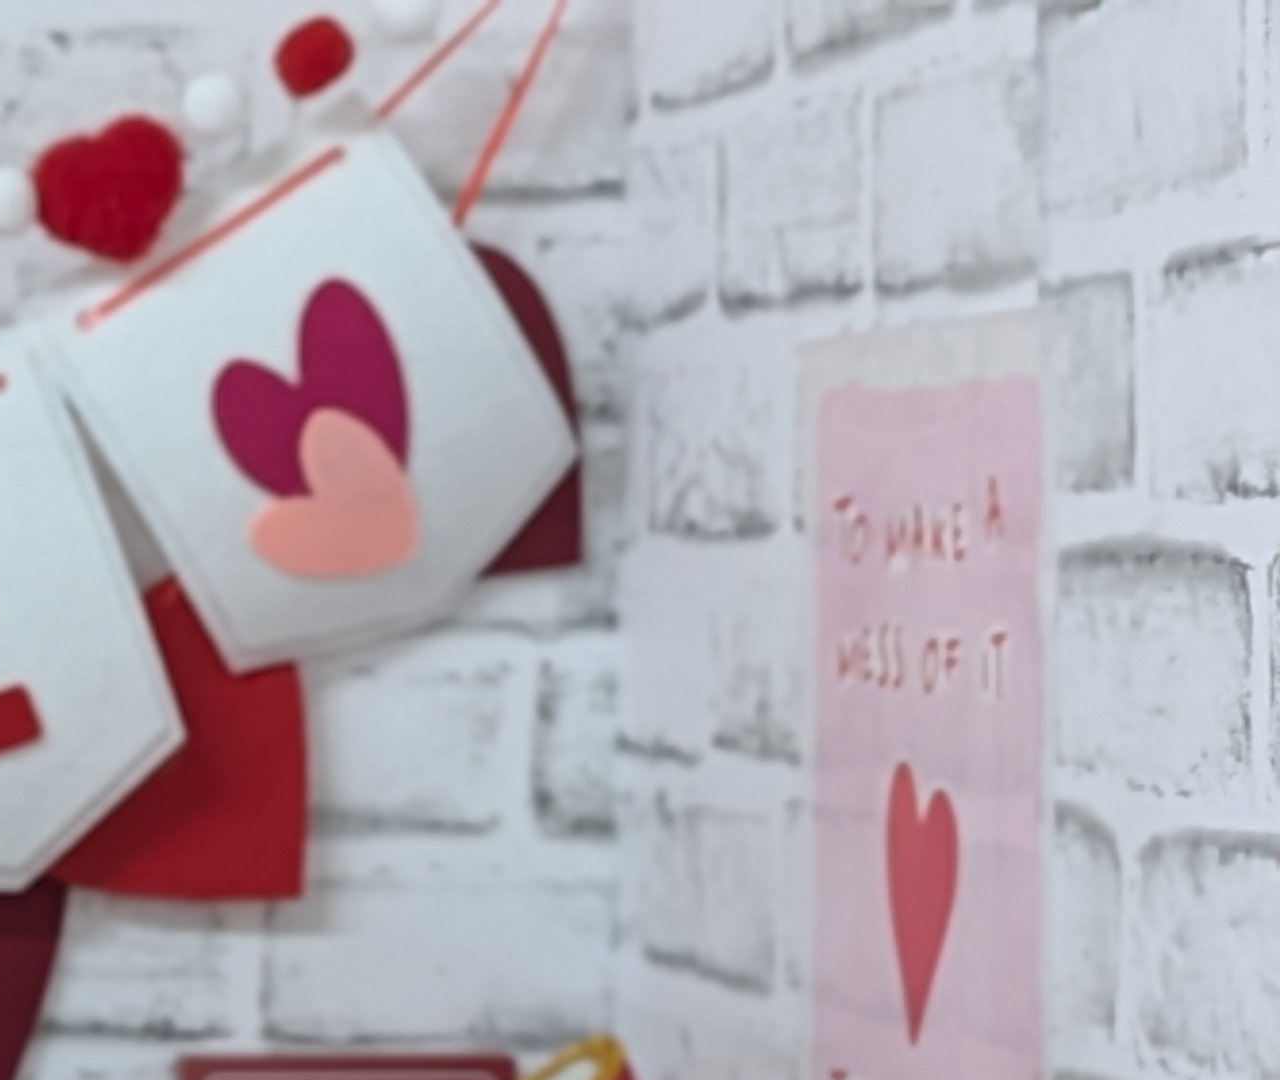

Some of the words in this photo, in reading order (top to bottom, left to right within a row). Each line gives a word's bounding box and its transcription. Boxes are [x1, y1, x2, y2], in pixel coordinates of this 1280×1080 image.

[833, 495, 868, 566] TO
[884, 503, 965, 562] MAKE
[984, 476, 1004, 540] A
[837, 622, 904, 690] MESS
[921, 637, 960, 694] OF
[981, 632, 1007, 700] IT
